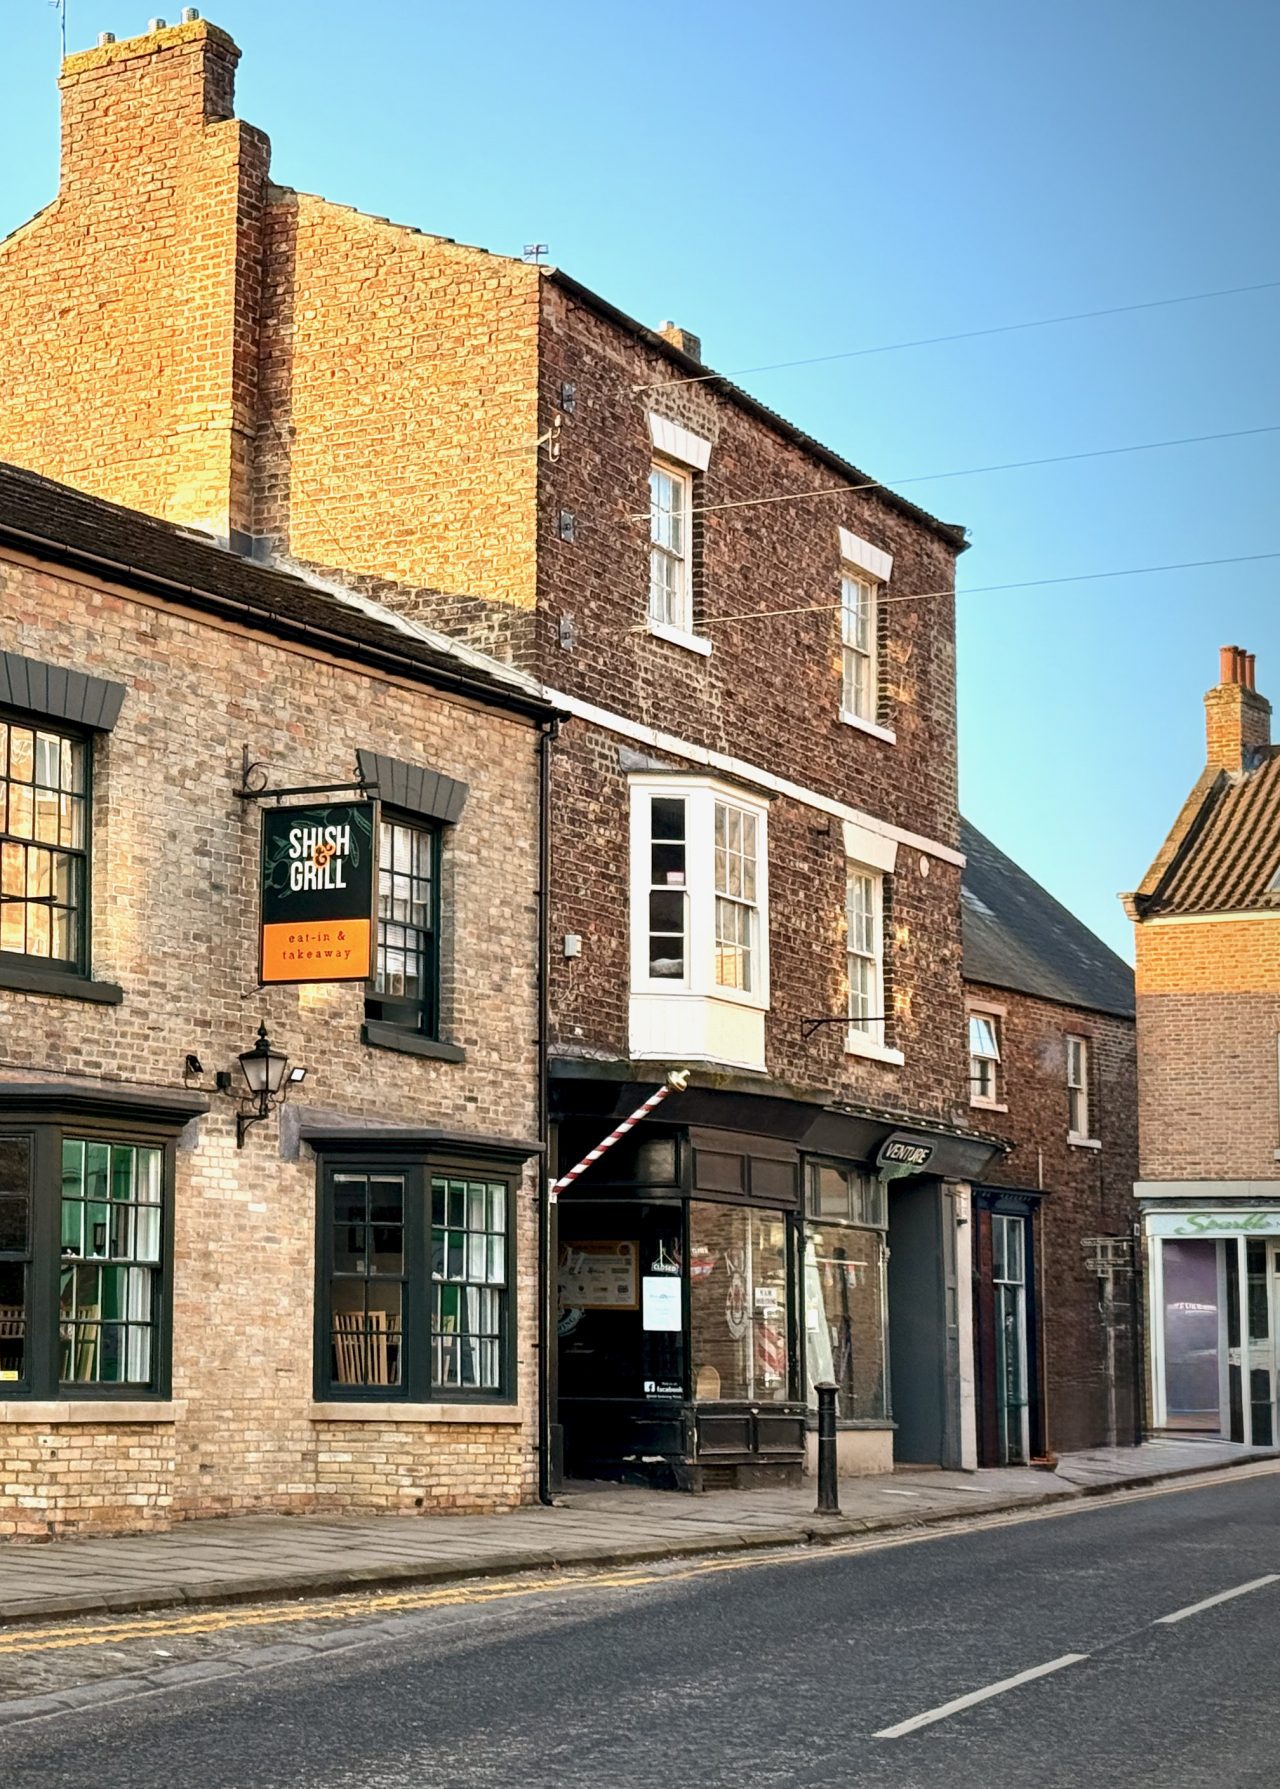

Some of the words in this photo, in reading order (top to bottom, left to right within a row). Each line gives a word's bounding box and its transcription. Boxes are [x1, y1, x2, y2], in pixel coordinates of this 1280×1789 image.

[288, 825, 351, 859] SHISH
[313, 844, 336, 868] &
[289, 858, 347, 892] GRILL
[288, 931, 331, 944] eat-in
[337, 930, 346, 942] &
[282, 948, 352, 961] takeaway
[885, 1143, 930, 1164] VENTURE
